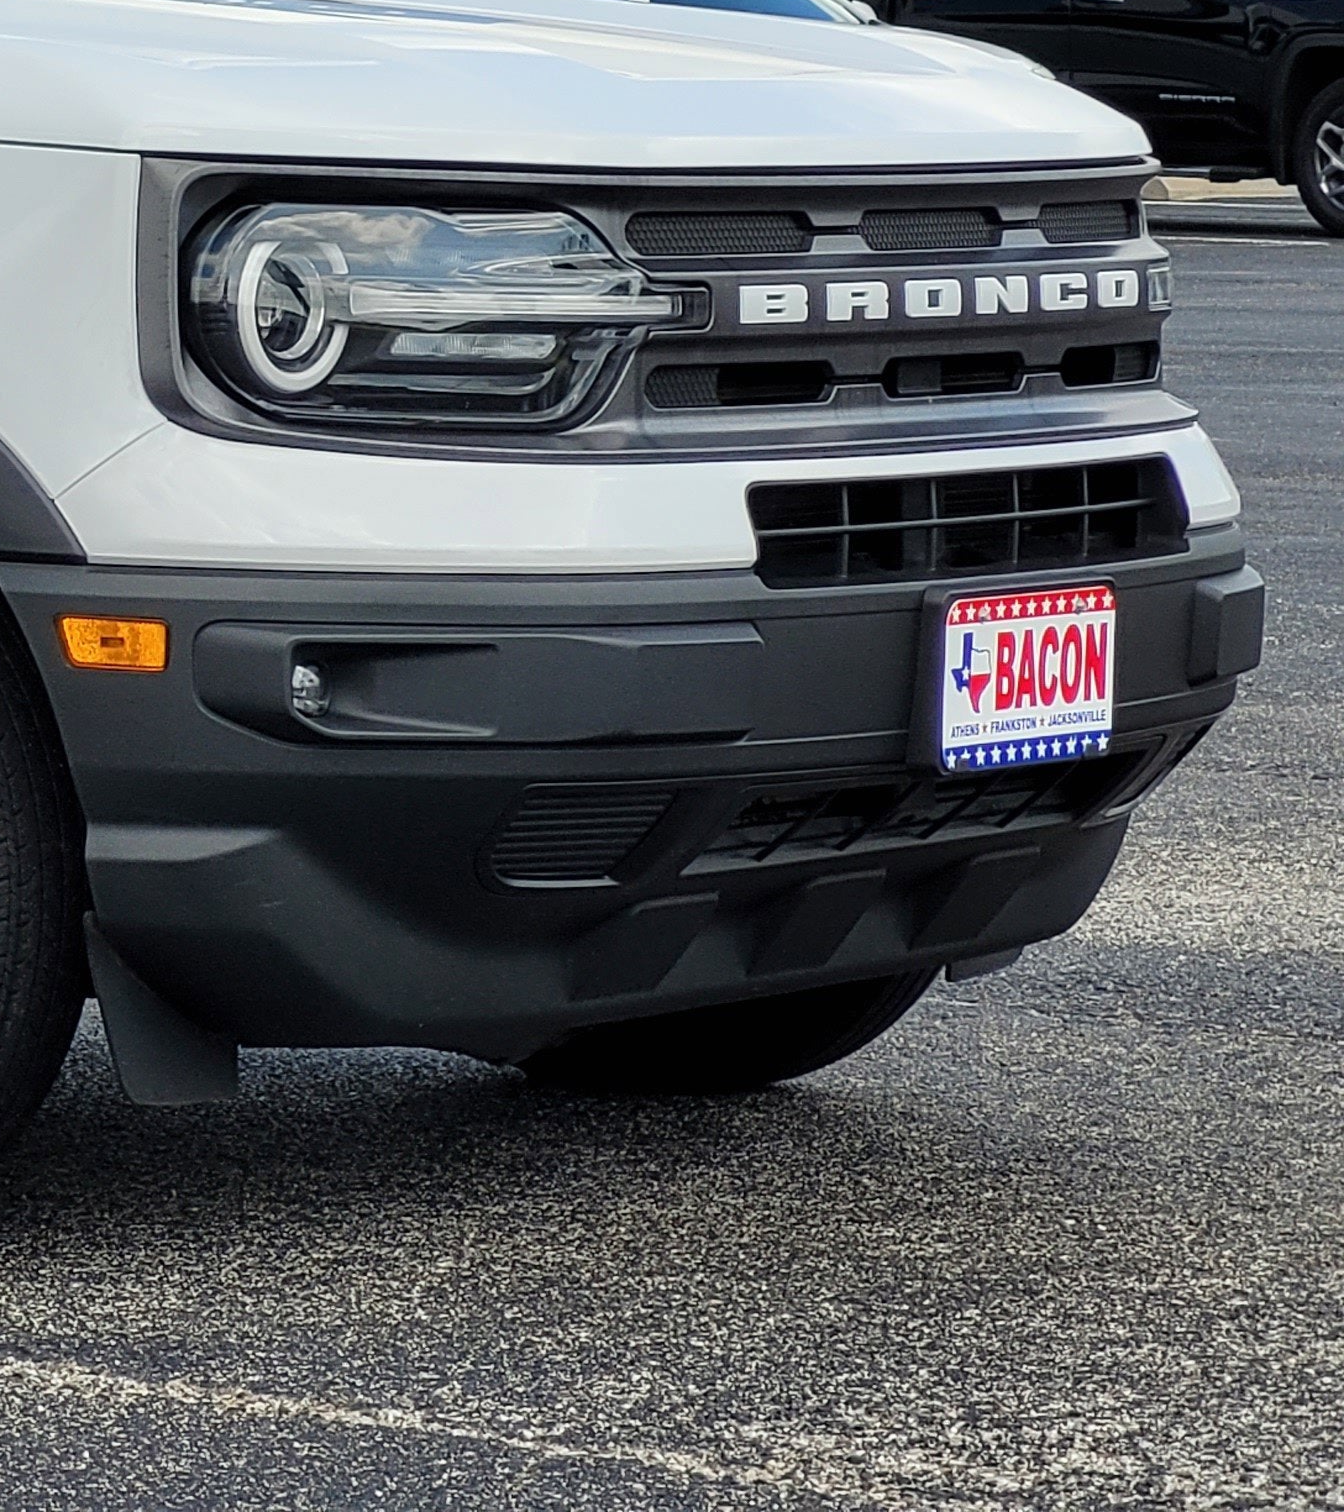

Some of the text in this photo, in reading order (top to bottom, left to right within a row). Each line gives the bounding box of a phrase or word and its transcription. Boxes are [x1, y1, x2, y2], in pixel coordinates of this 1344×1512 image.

[739, 270, 1140, 325] BRONCO
[994, 622, 1108, 711] BACON
[950, 709, 1106, 739] ATHENS FRANKSTON JACKSONVILLE
